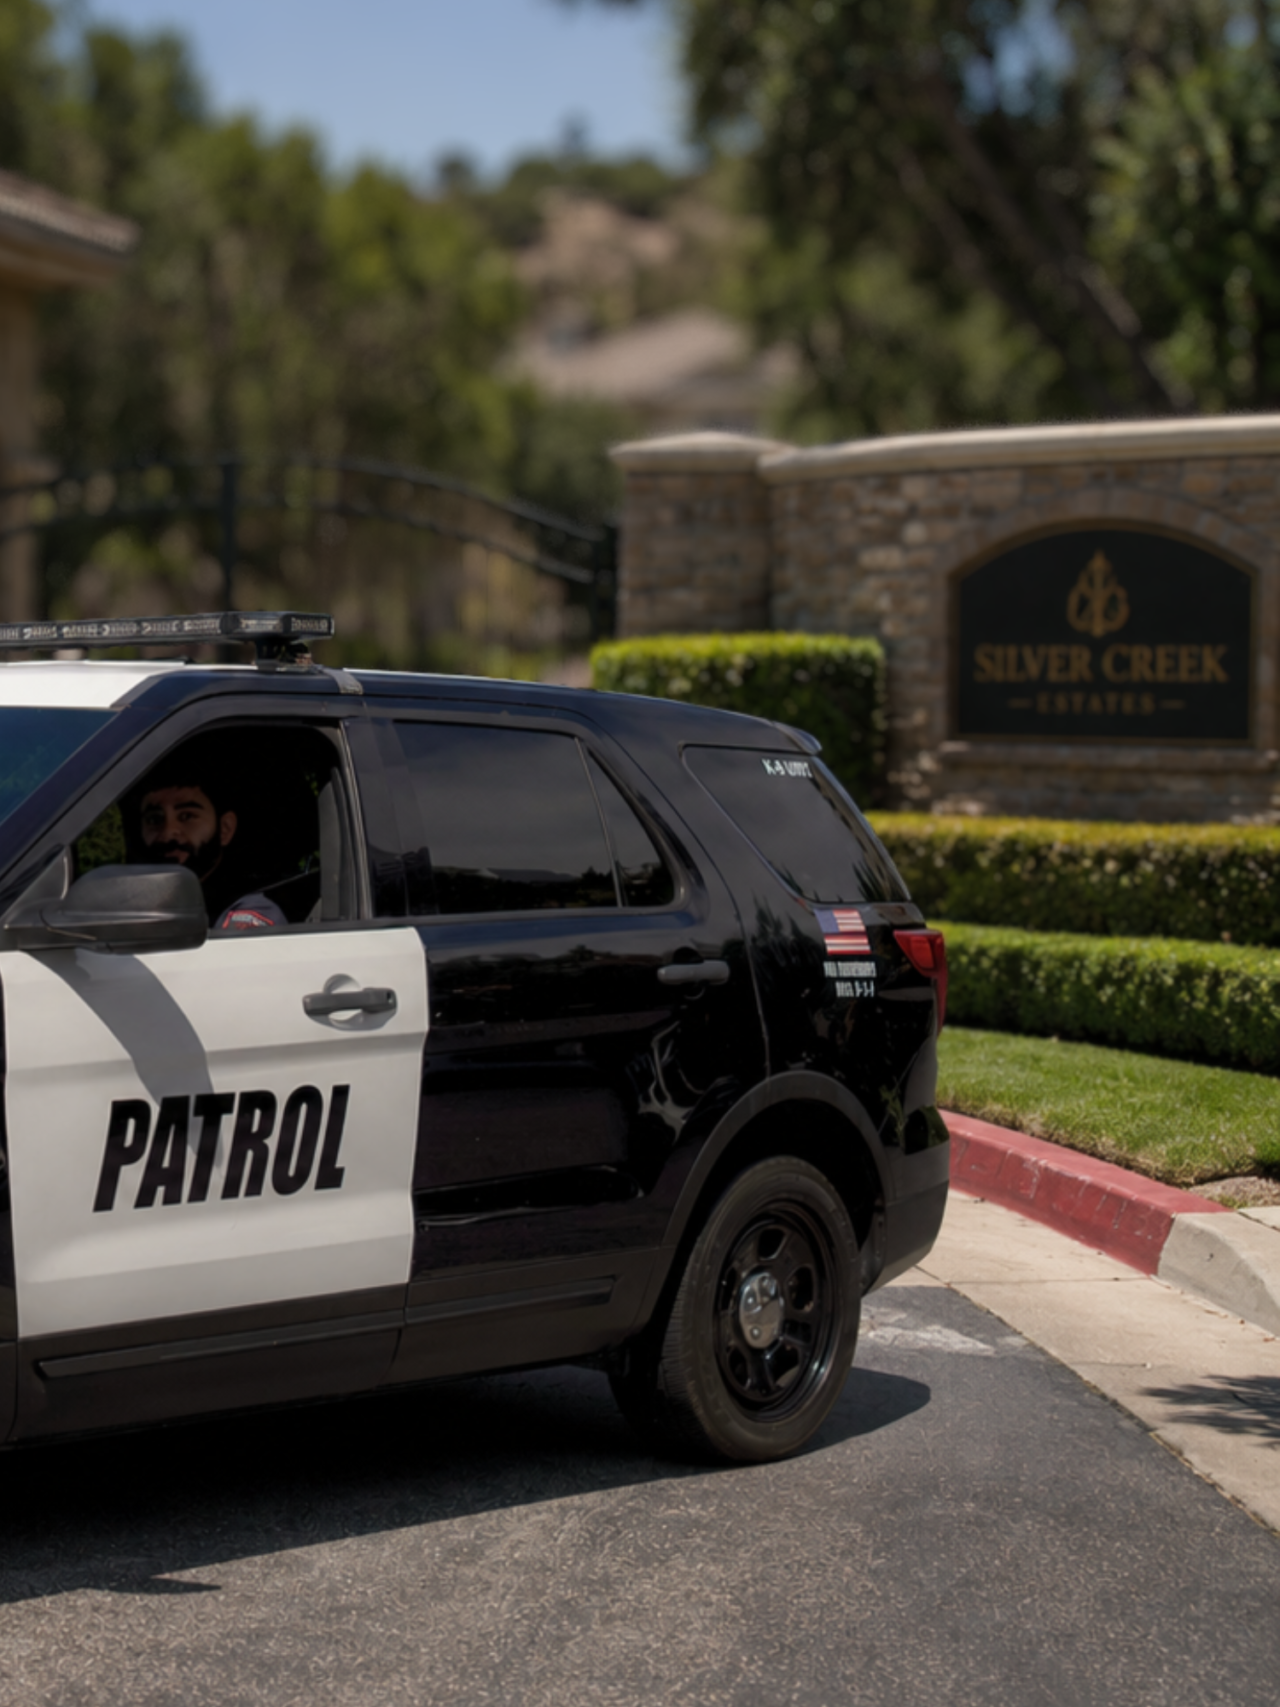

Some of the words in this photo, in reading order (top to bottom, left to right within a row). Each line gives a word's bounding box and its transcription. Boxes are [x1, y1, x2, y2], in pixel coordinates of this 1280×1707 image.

[973, 643, 1094, 683] SILVER
[1102, 643, 1228, 683] CREEK
[1036, 692, 1155, 715] ESTATES
[92, 1084, 350, 1213] PATROL
